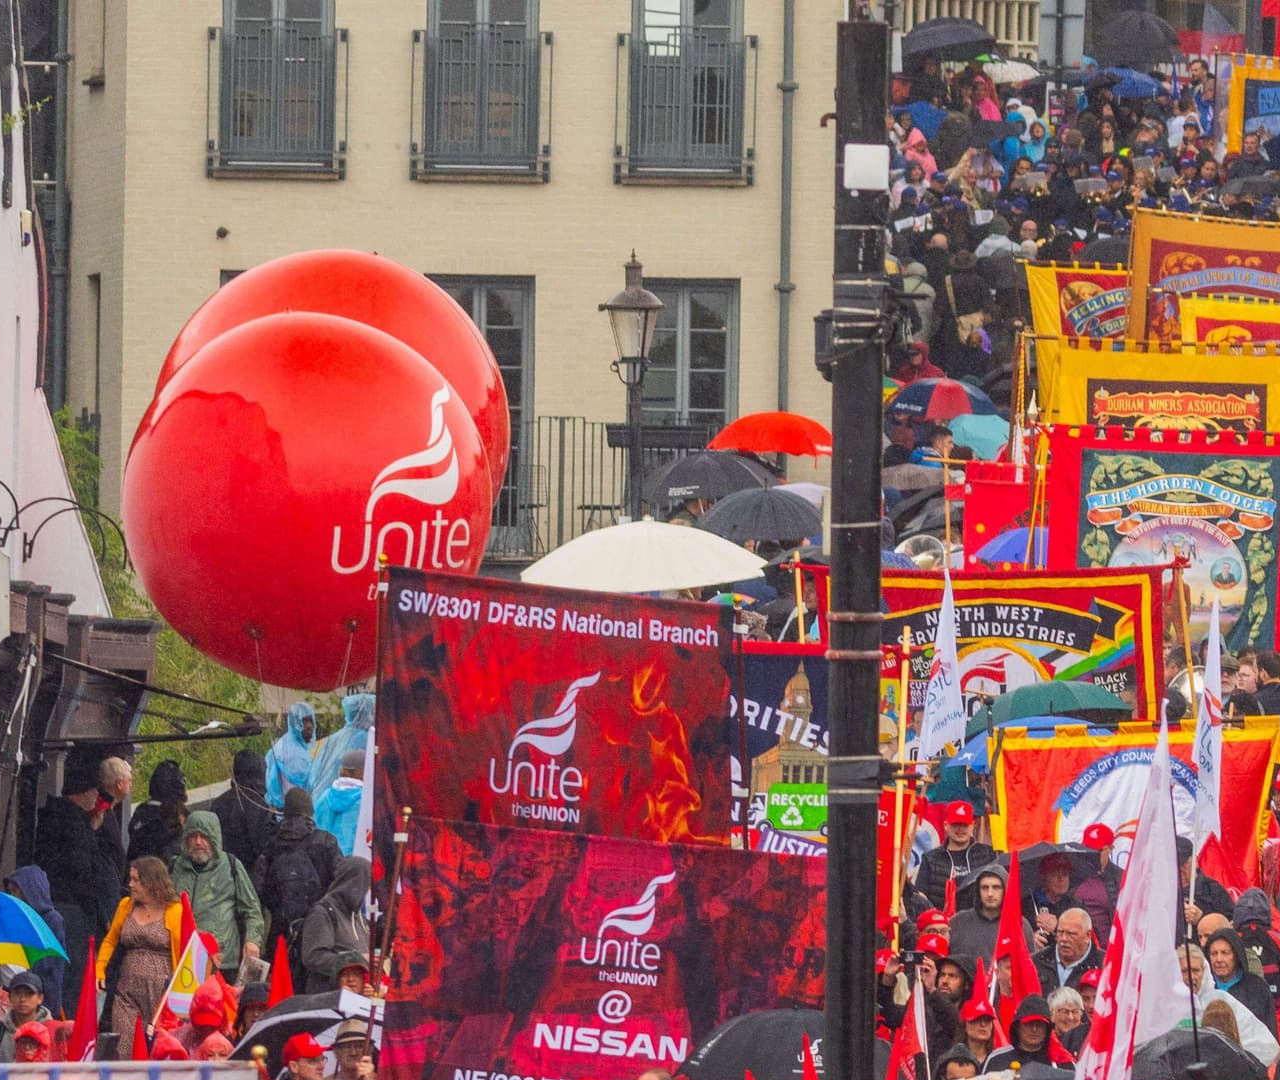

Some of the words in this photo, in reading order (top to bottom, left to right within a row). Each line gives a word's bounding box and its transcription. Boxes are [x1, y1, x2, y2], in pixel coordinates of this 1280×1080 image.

[1072, 291, 1128, 320] KELLING
[1107, 399, 1144, 411] DURHAM
[1188, 400, 1247, 414] ASSOCIATION
[1099, 491, 1133, 506] THE
[1138, 477, 1203, 497] HORDEN
[1209, 487, 1262, 512] LODGE
[1134, 502, 1170, 514] DURHAM
[331, 510, 470, 574] unite
[398, 589, 480, 622] SW/8301
[488, 602, 556, 630] DF&RS
[562, 610, 643, 640] National
[650, 619, 719, 647] Branch
[996, 606, 1043, 622] WEST
[972, 622, 1076, 647] INDUSTRIES
[1094, 672, 1127, 686] BLACK
[489, 757, 583, 801] unite
[1070, 769, 1098, 799] LEEDS
[1099, 757, 1119, 773] CITY
[1122, 751, 1155, 763] COUNC
[512, 803, 581, 824] theUNION
[771, 793, 828, 806] RECYCLI
[580, 936, 661, 970] unite
[599, 969, 657, 987] theUNION
[598, 989, 632, 1023] @
[534, 1023, 688, 1062] NISSAN
